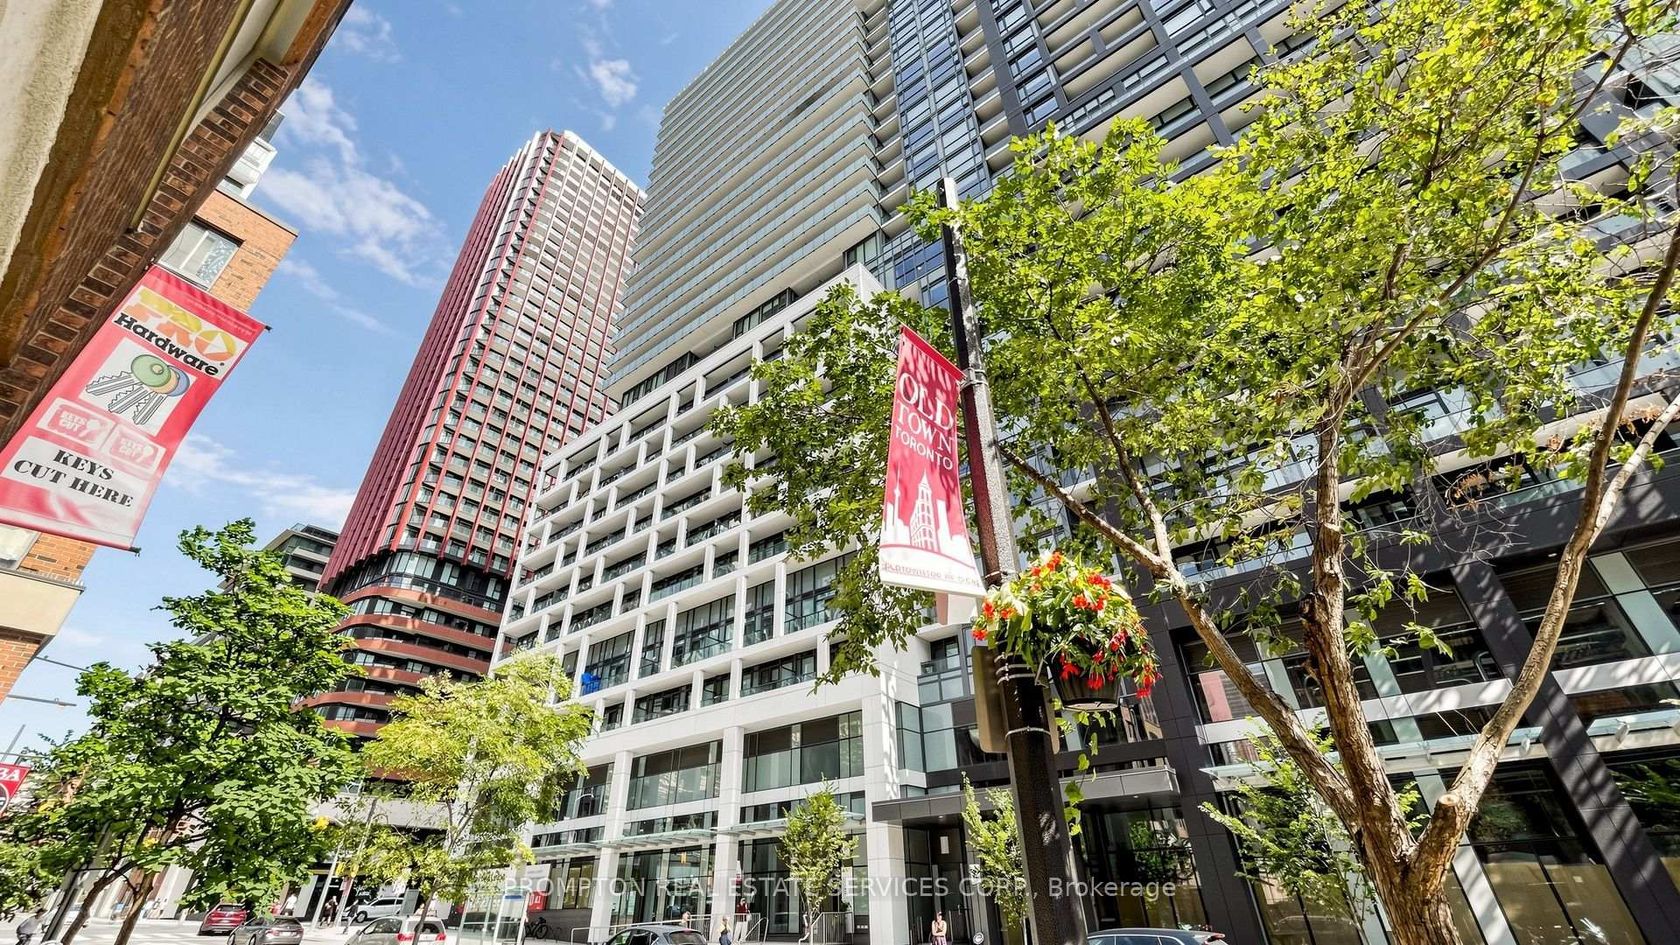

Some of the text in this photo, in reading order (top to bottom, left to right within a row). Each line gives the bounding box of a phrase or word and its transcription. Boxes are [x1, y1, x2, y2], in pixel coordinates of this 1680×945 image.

[114, 312, 219, 376] Hardware
[897, 399, 953, 454] TOWN
[899, 372, 954, 430] OLD
[53, 450, 114, 480] KEYS
[895, 425, 953, 470] TORONTO
[13, 459, 134, 508] CUT HERE
